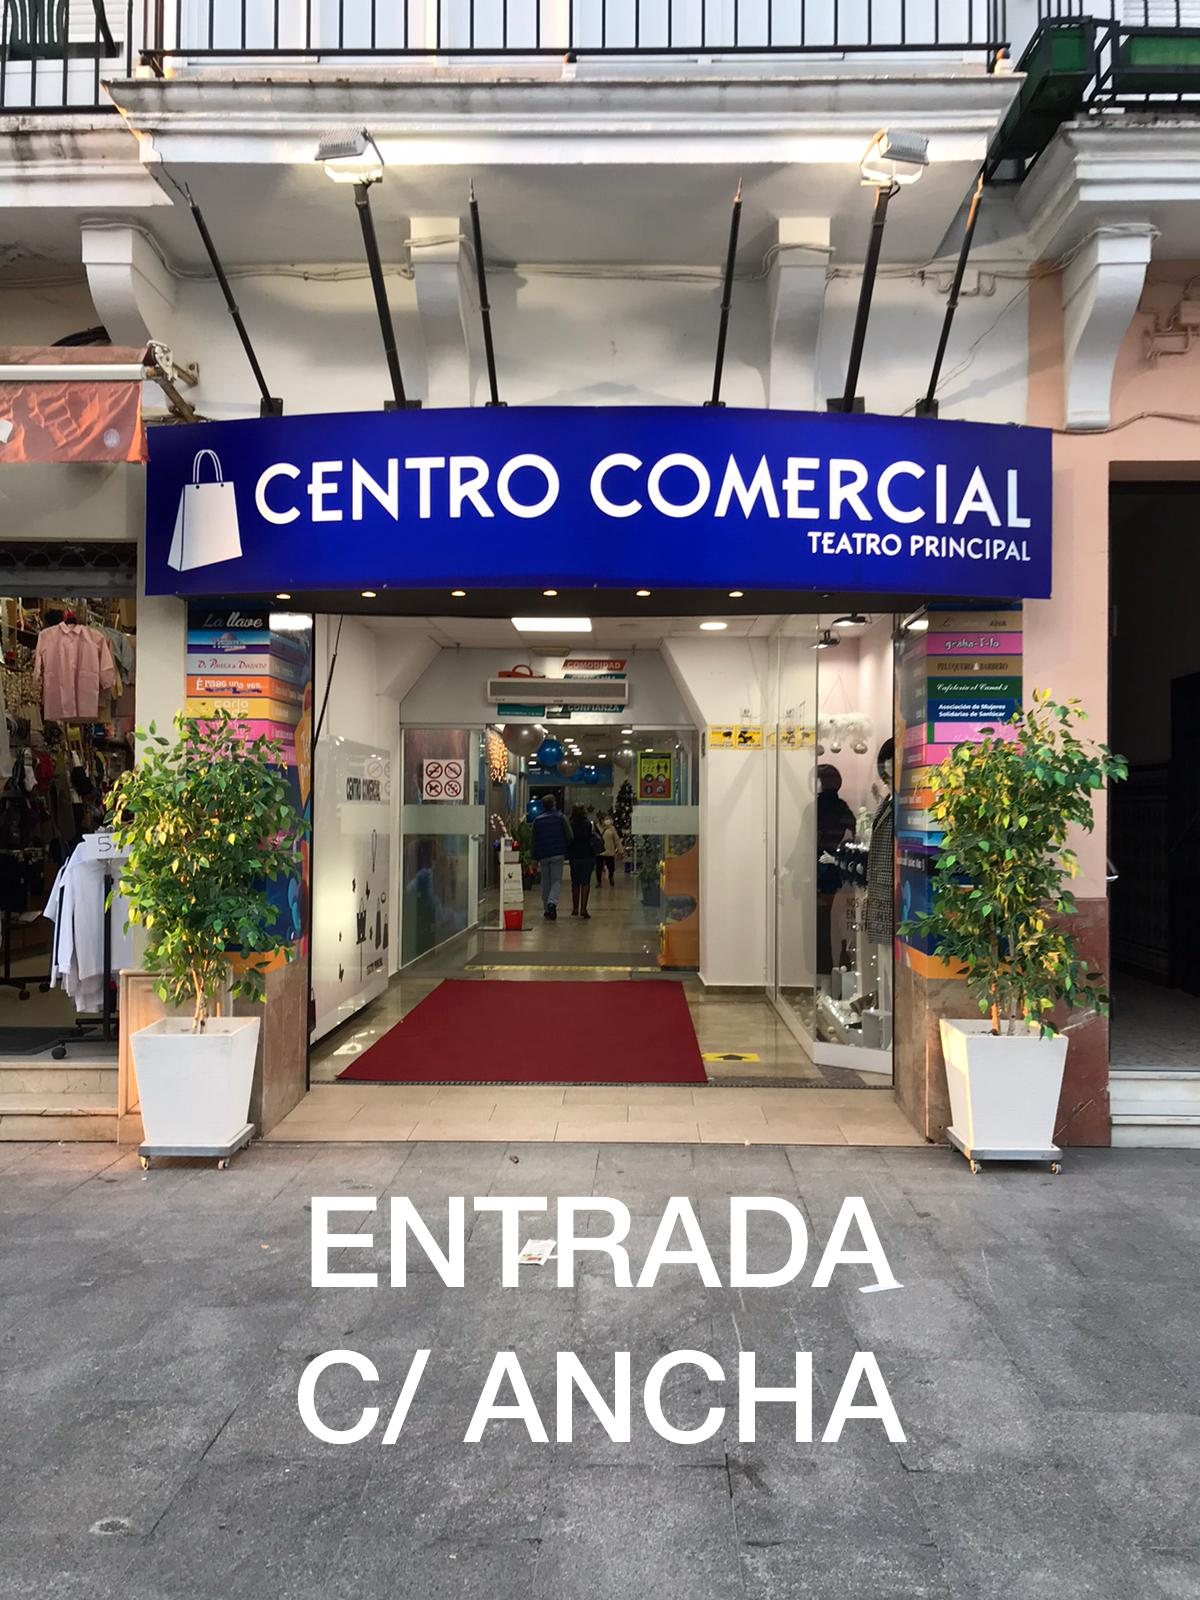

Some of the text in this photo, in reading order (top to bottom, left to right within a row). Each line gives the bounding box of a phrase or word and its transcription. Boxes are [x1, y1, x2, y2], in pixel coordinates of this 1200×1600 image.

[255, 452, 1031, 528] CENTRO COMERCIAL
[807, 531, 1031, 561] TEATRO PRINCIPAL
[202, 611, 263, 628] La llave
[566, 661, 622, 670] COMODIDAD
